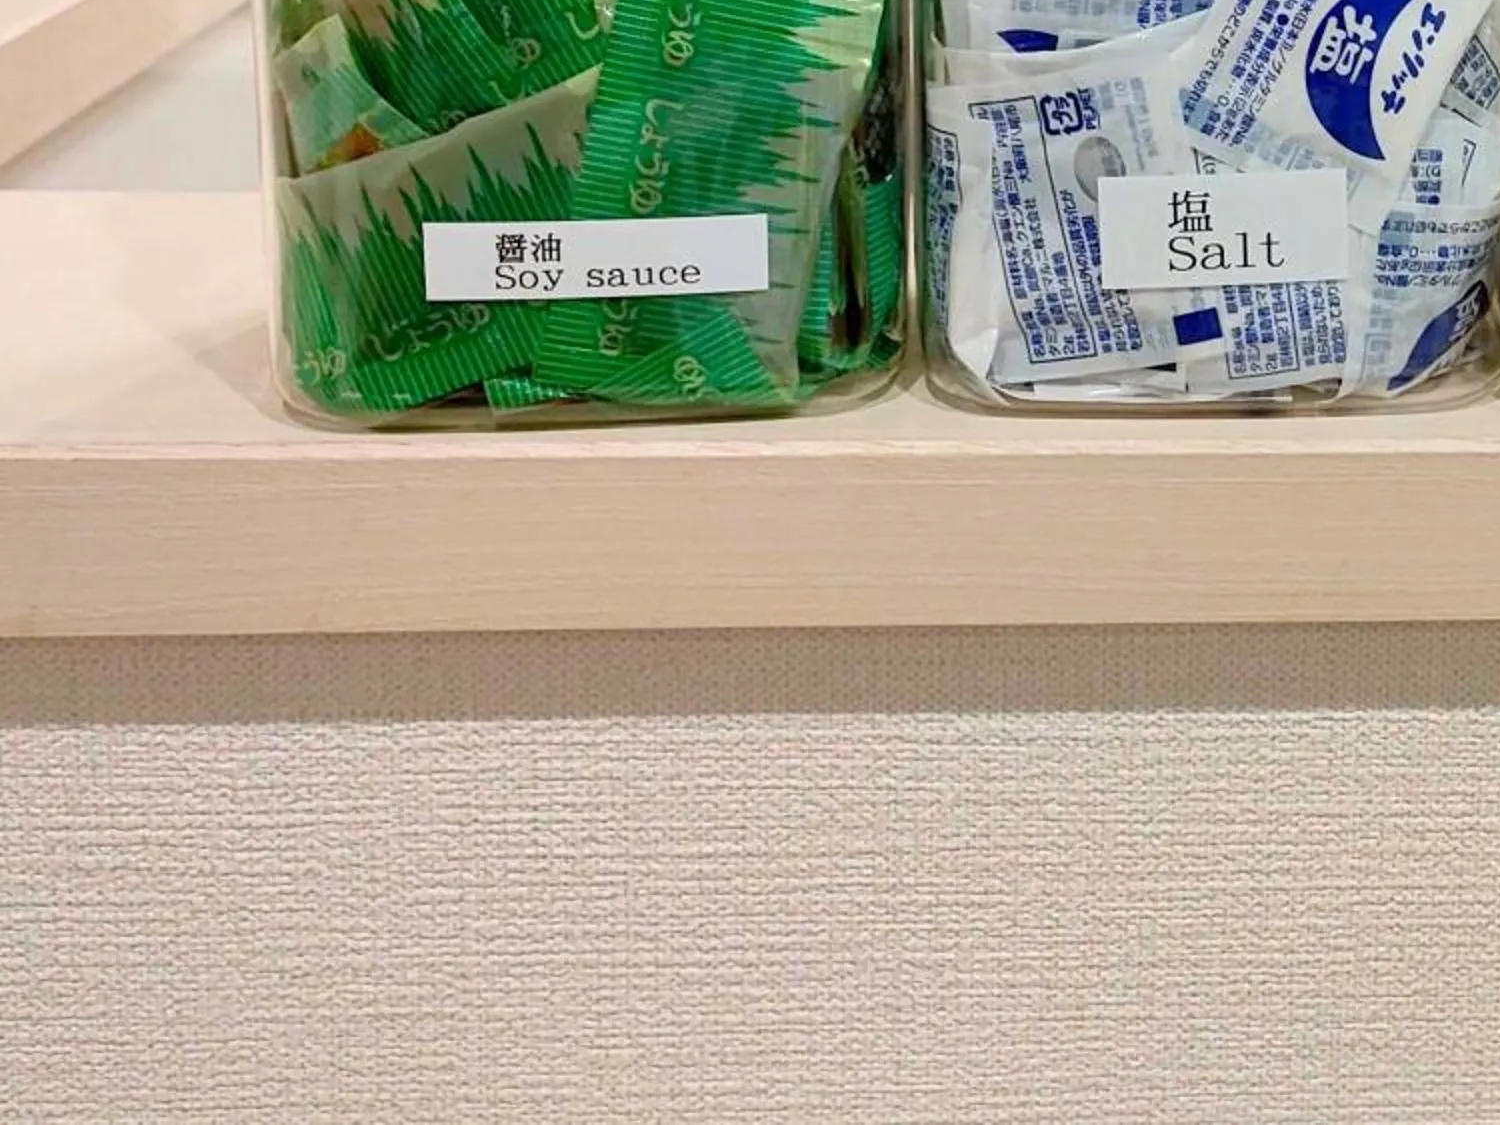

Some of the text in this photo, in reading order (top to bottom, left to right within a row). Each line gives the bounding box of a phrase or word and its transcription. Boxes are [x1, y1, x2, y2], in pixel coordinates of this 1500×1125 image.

[1310, 5, 1388, 86] 塩
[628, 99, 686, 214] しょうゆ
[1168, 190, 1213, 233] 塩
[496, 233, 562, 263] 醤油
[1168, 231, 1285, 272] Salt
[495, 263, 701, 291] Soy sauce
